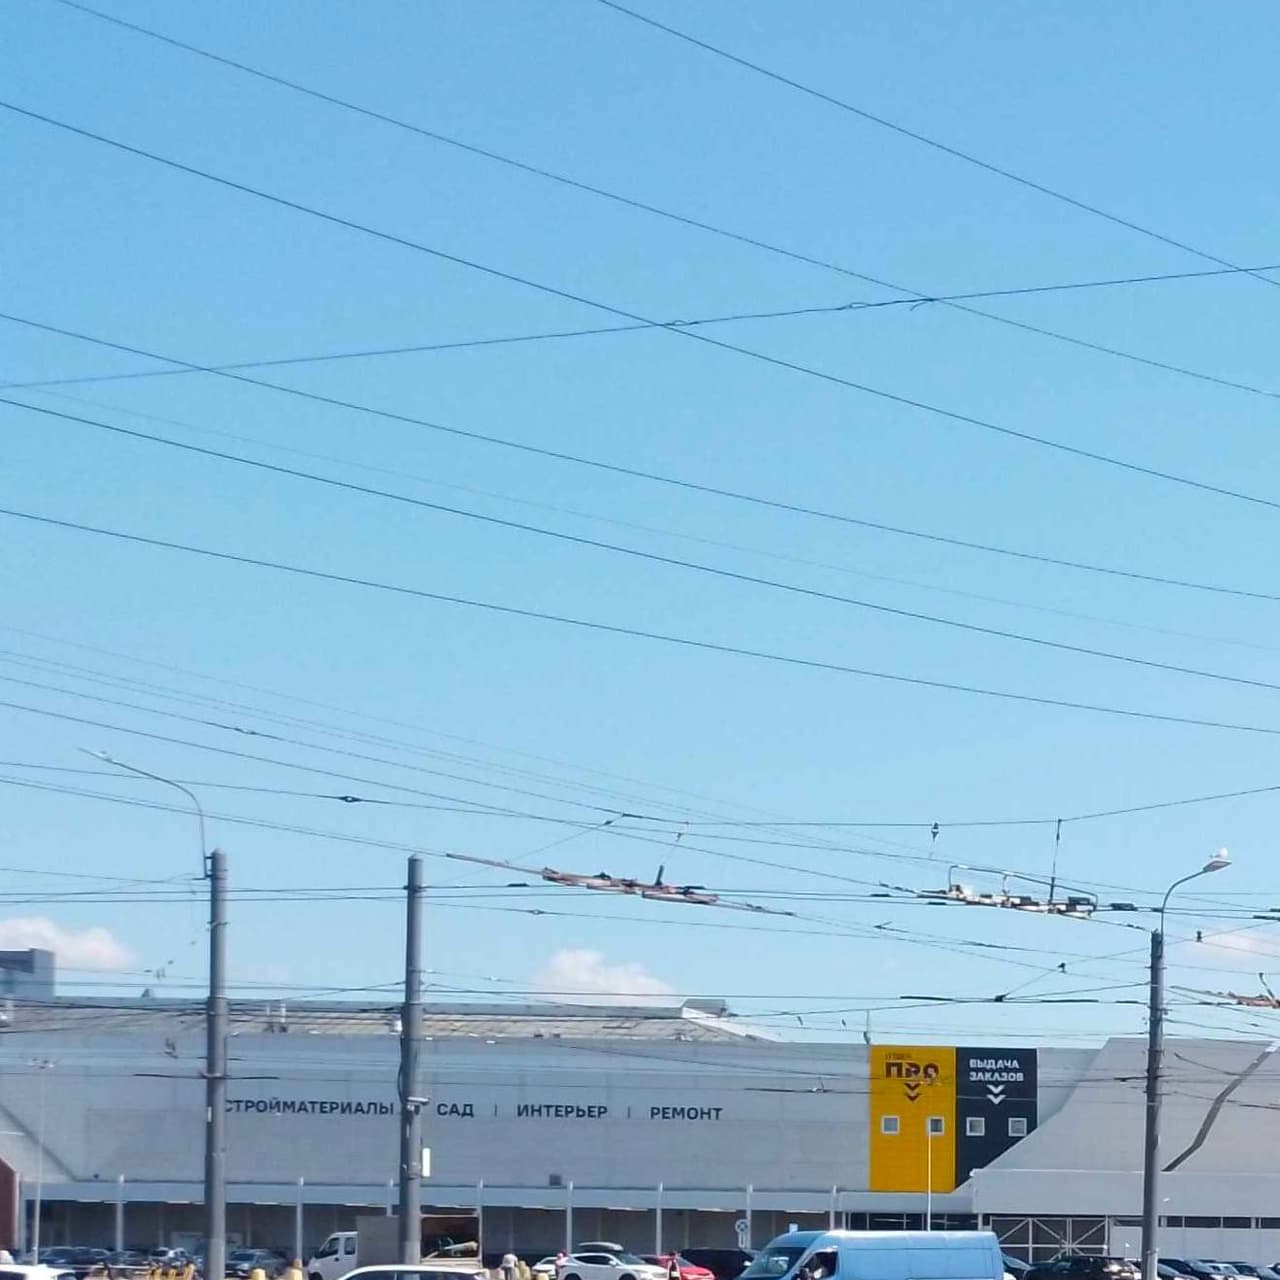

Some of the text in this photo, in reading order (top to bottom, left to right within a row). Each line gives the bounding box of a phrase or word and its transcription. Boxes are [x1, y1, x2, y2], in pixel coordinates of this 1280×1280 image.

[969, 1058, 1020, 1070] ВЫДАЧА
[969, 1071, 1024, 1082] ЗАКАЗОВ
[225, 1097, 724, 1120] СТРОЙМАТЕРИАЛЫ САД ИНТЕРЬЕР РЕМОНТ
